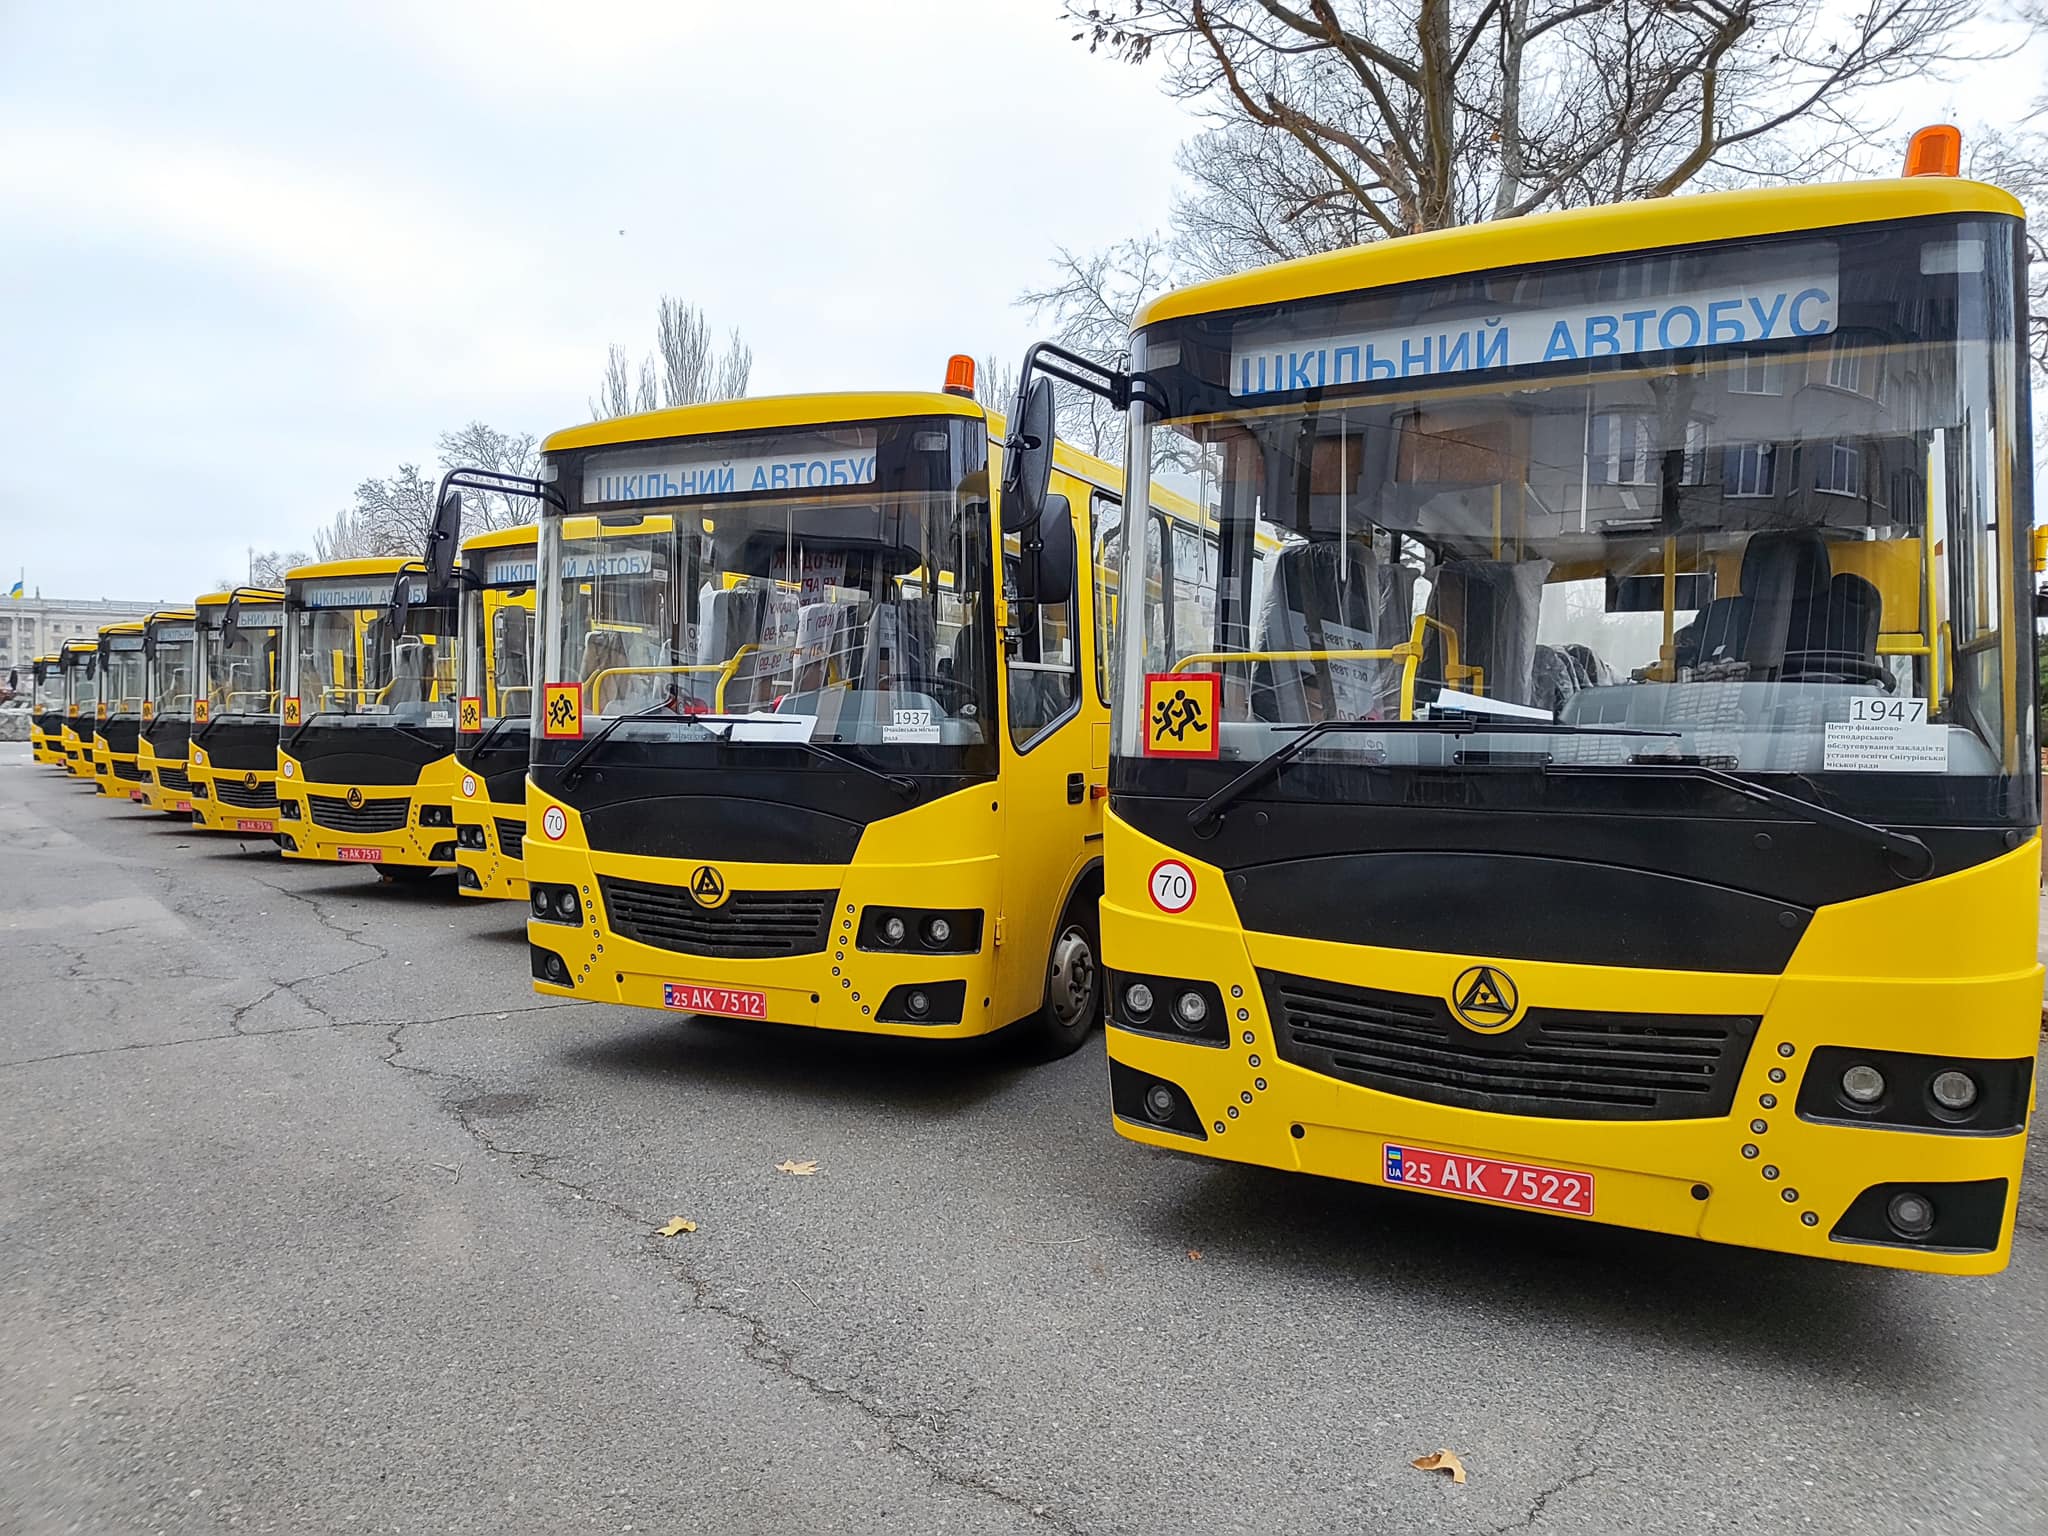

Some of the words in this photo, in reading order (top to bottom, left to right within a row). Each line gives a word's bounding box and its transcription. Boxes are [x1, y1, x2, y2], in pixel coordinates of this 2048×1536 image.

[1241, 317, 1509, 396] ШКІЛЬНИЙ
[1541, 287, 1831, 362] АВТОБУС
[1852, 700, 1924, 722] 1947
[895, 712, 929, 725] 1937
[1827, 723, 1855, 732] Центр
[1827, 734, 1894, 742] господарського
[1826, 742, 1894, 752] обслуговування
[1896, 745, 1933, 753] закладів
[1826, 752, 1860, 760] установ
[1861, 753, 1888, 761] освіти
[465, 780, 474, 791] 70
[548, 815, 562, 831] 70
[349, 848, 360, 859] AK
[361, 849, 380, 859] 7517
[1159, 875, 1187, 898] 70
[673, 992, 688, 1006] 25
[692, 989, 714, 1009] AK
[720, 991, 760, 1014] 7512
[1388, 1167, 1402, 1178] UA
[1404, 1161, 1432, 1184] 25
[1440, 1159, 1487, 1193] AK
[1501, 1168, 1582, 1208] 7522
